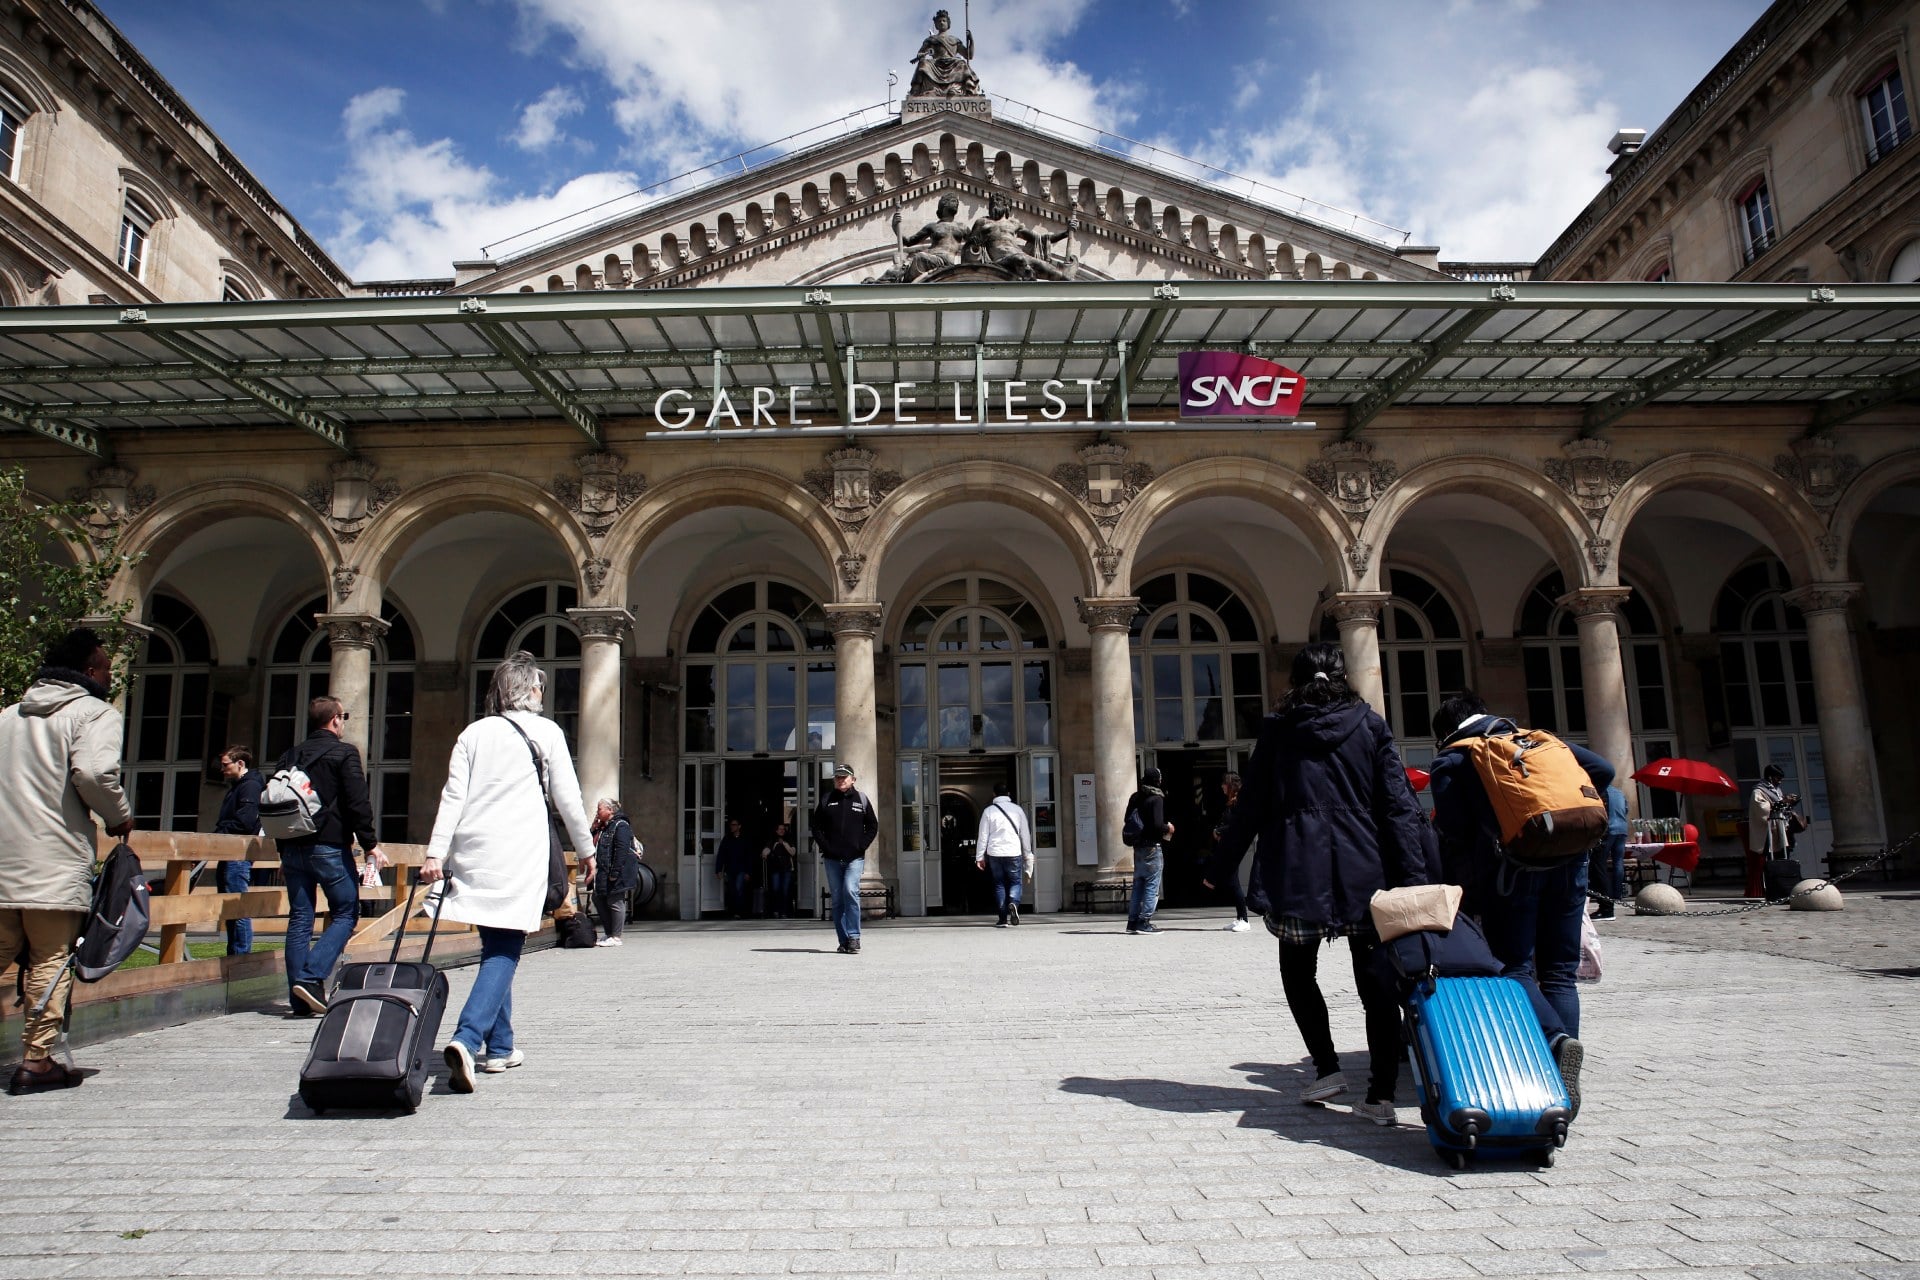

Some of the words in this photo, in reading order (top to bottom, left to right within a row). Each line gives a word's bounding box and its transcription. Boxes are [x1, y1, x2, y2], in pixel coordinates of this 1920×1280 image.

[654, 386, 812, 429] GARE
[850, 382, 917, 423] DE
[954, 379, 1102, 421] L'EST
[1186, 375, 1299, 408] SNCF
